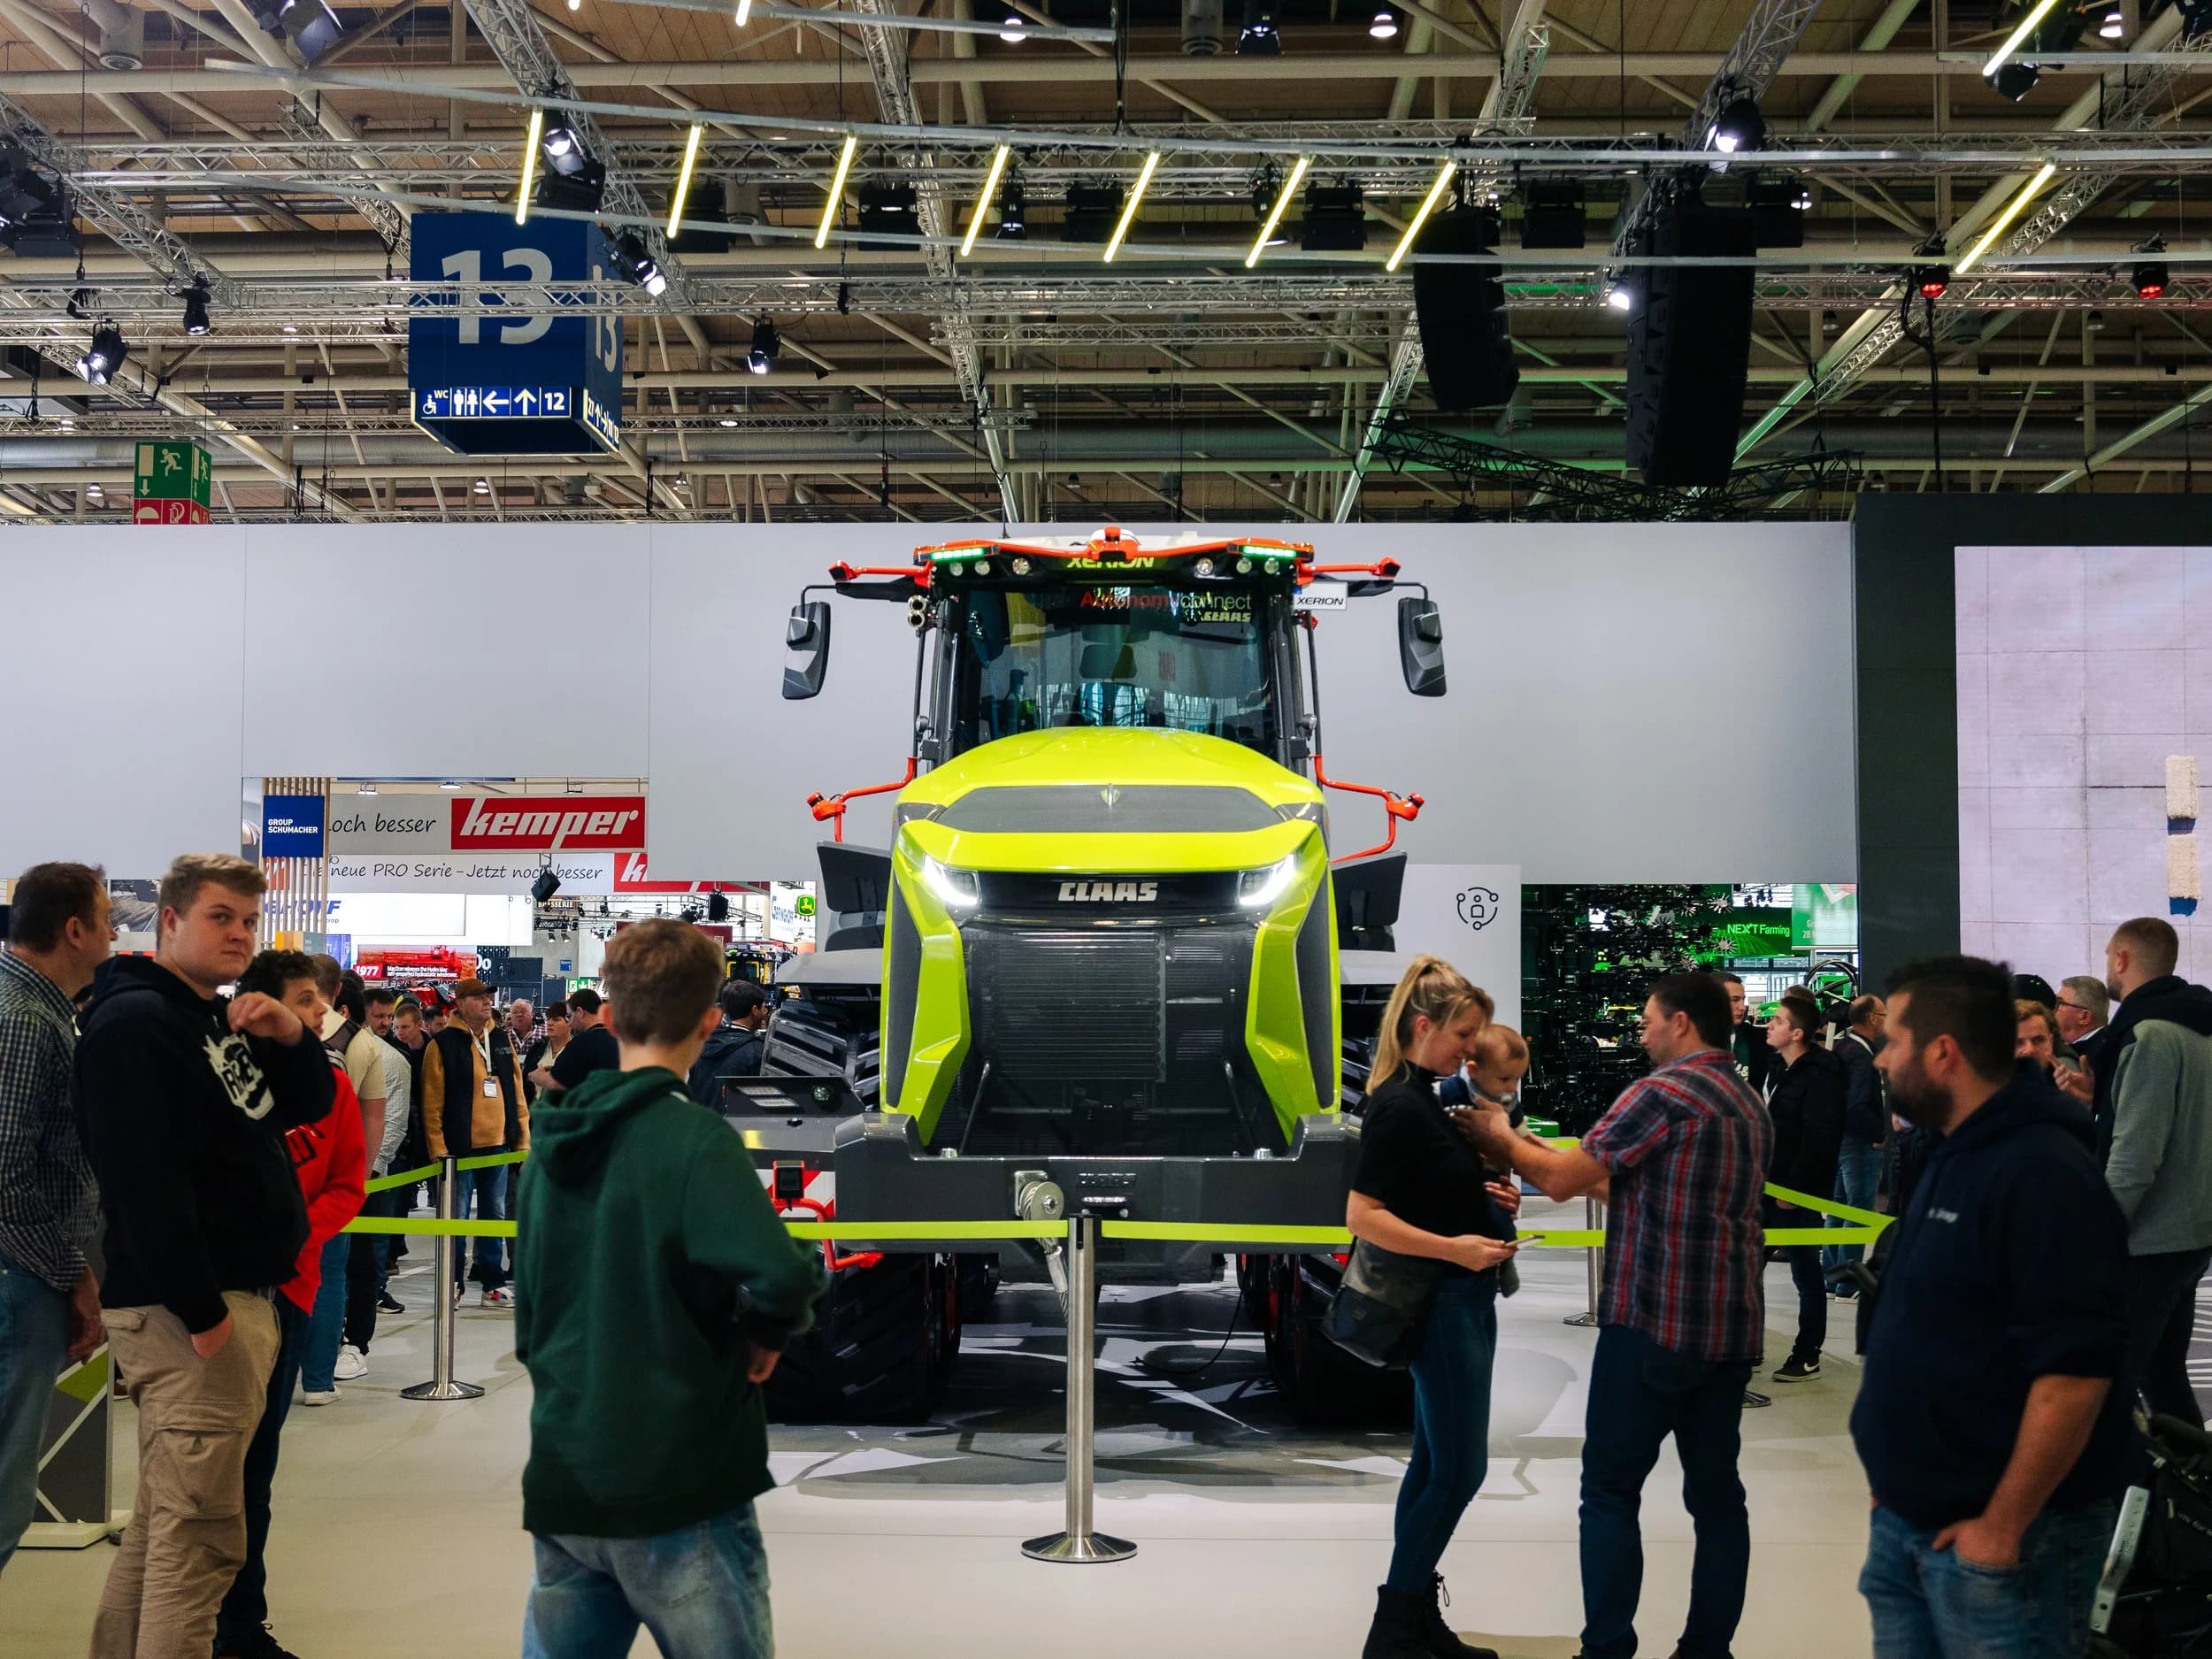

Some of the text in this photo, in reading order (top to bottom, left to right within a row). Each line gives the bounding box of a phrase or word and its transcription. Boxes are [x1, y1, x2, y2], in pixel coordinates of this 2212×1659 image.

[442, 248, 553, 344] 13
[434, 389, 449, 399] WC
[544, 392, 566, 411] 12
[1297, 596, 1344, 605] XERION
[329, 812, 437, 833] och besser
[459, 797, 639, 849] kemper
[331, 866, 366, 877] neue
[373, 864, 408, 877] PRO
[414, 863, 453, 878] Serie
[466, 864, 507, 879] Jetzt
[557, 864, 603, 879] besser
[1058, 882, 1158, 902] CLAAS
[1759, 924, 1790, 937] Farming
[355, 965, 379, 977] 1977
